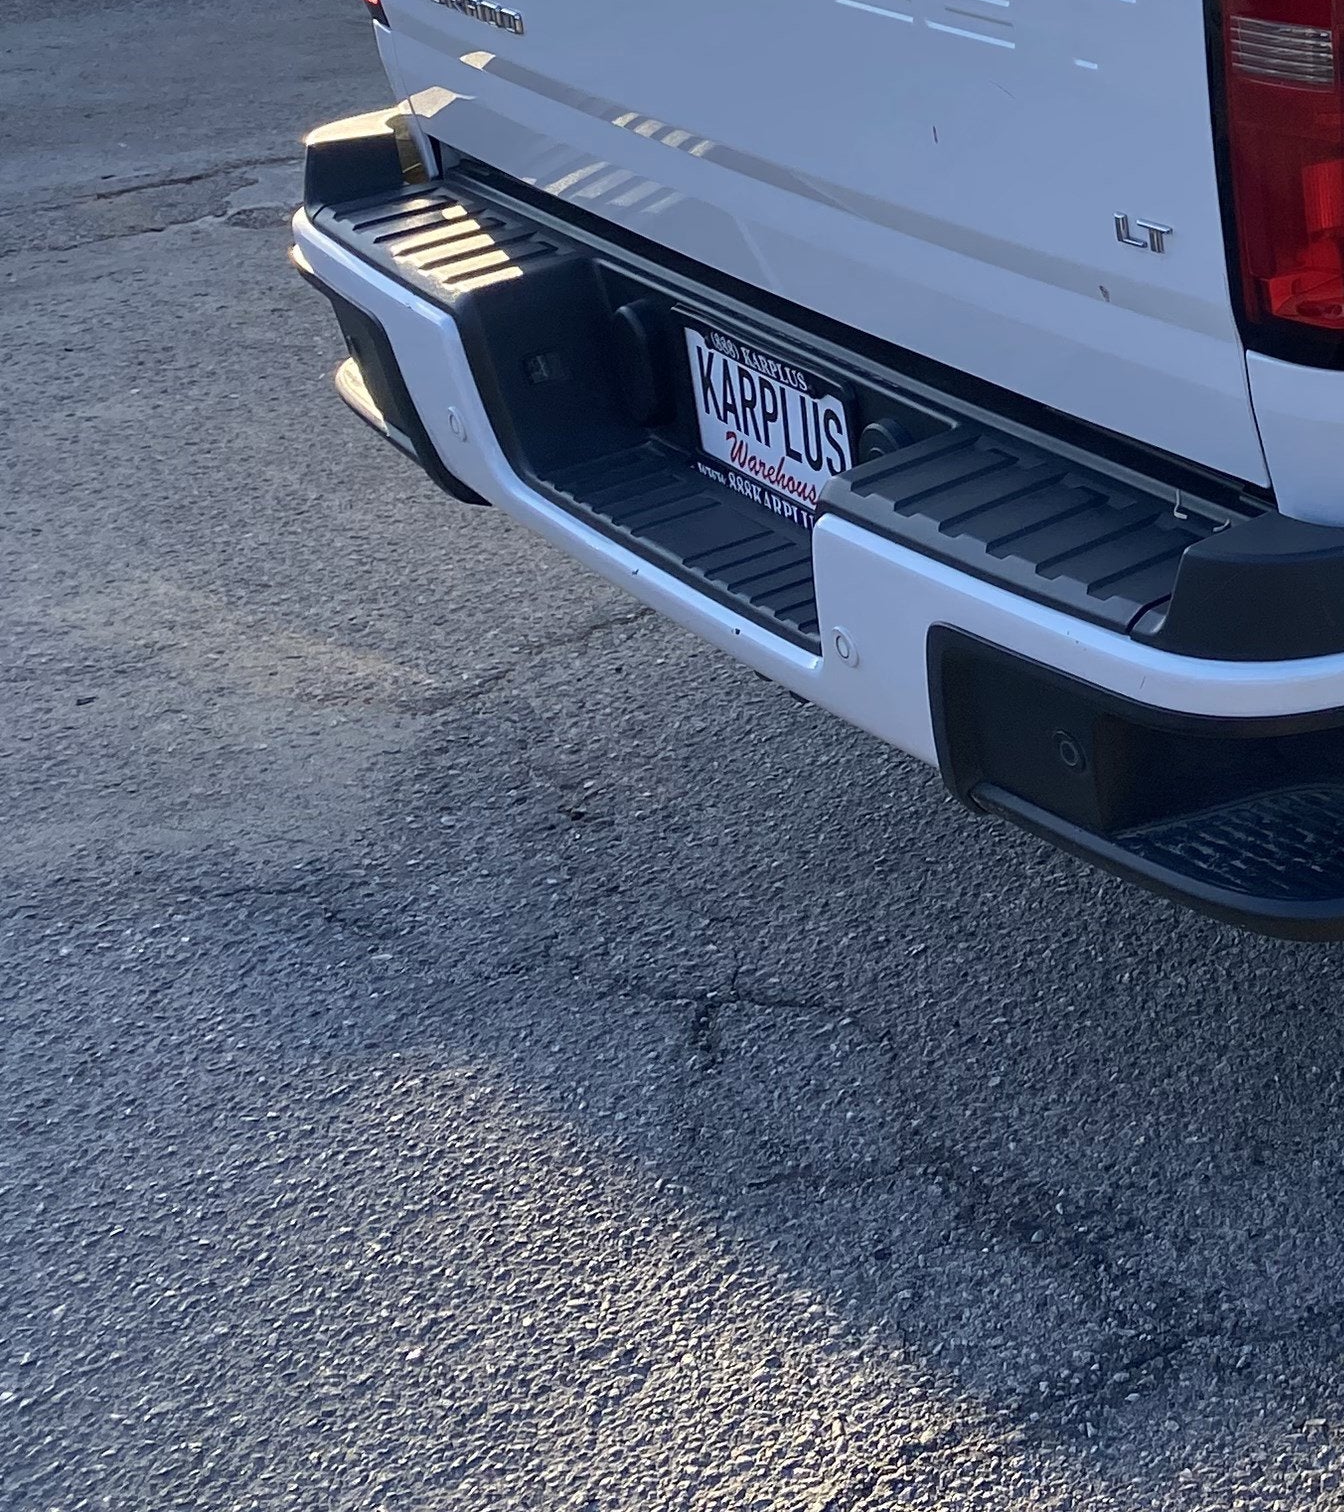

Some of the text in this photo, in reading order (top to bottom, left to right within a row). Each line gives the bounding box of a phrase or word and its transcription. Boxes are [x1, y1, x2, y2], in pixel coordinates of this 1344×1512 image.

[1113, 211, 1173, 254] LT
[740, 346, 808, 391] KARPLUS
[696, 345, 846, 477] KARPLUS
[725, 431, 818, 506] Warehous
